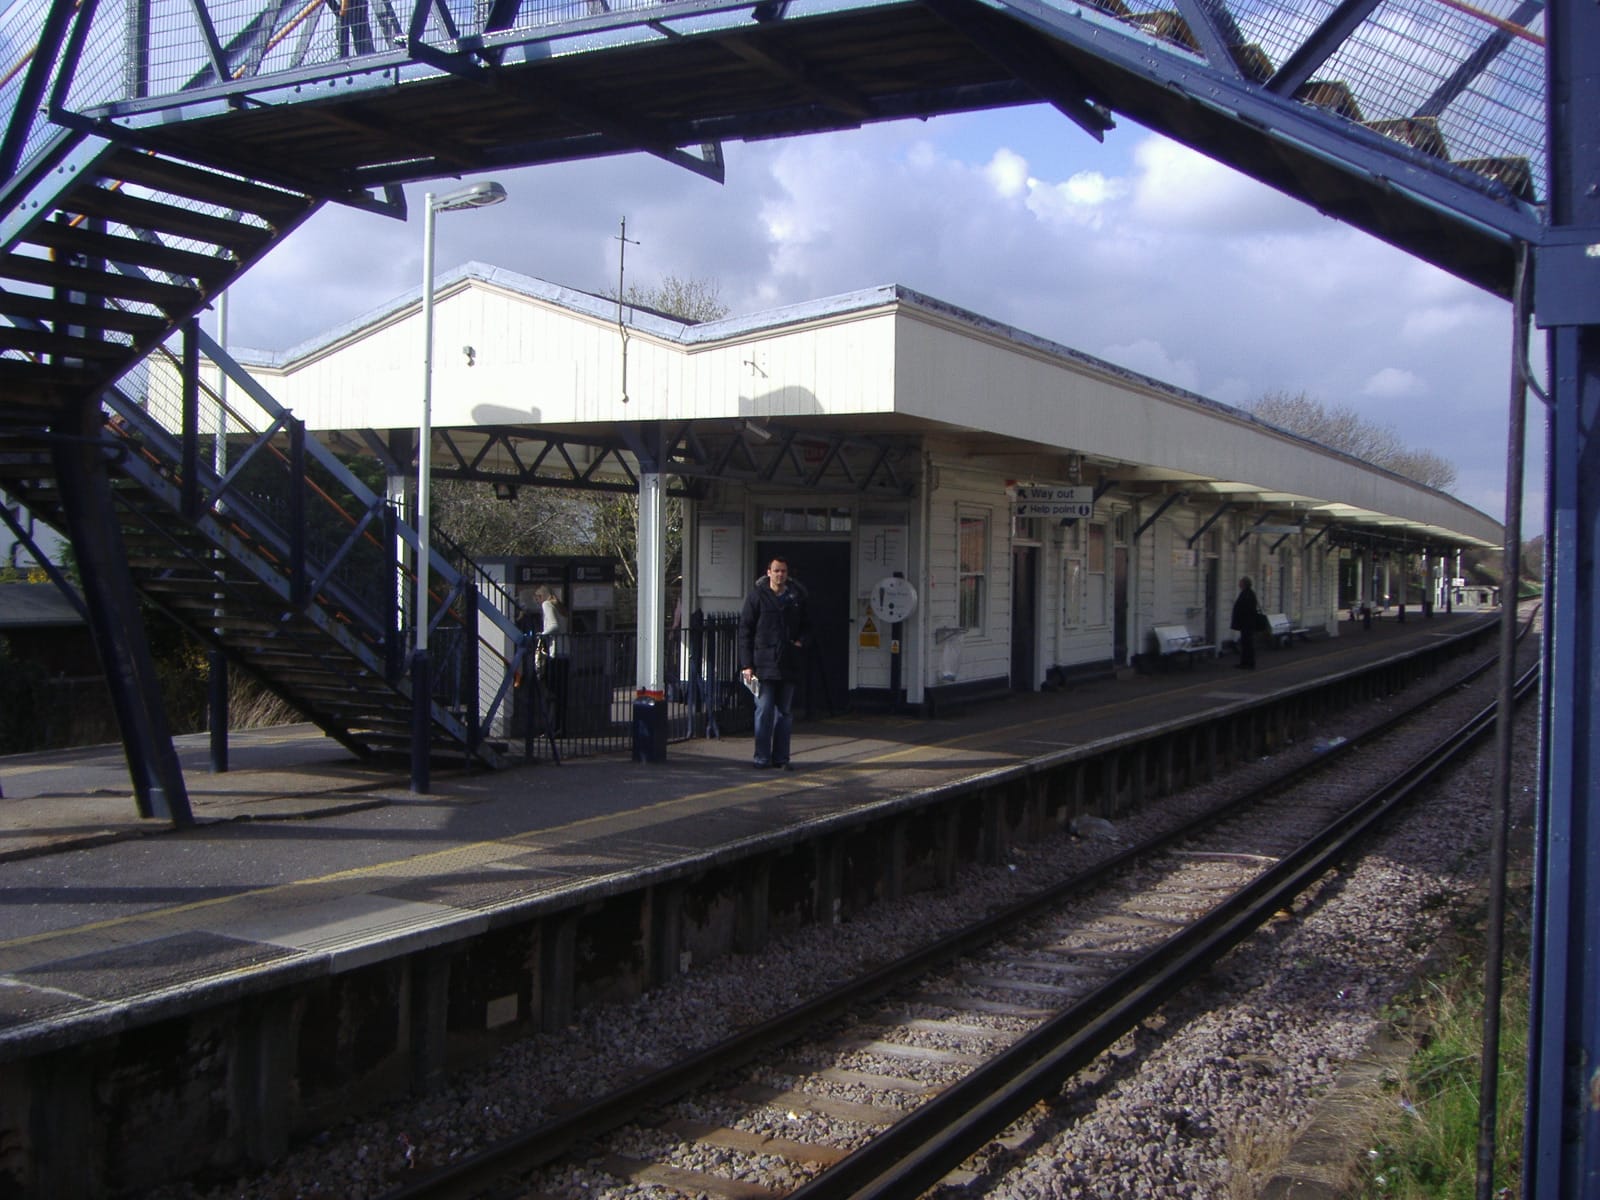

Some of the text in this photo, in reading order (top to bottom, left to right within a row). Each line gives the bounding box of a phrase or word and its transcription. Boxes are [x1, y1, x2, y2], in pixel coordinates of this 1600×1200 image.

[1031, 489, 1074, 500] Way out
[1030, 504, 1076, 514] Help point
